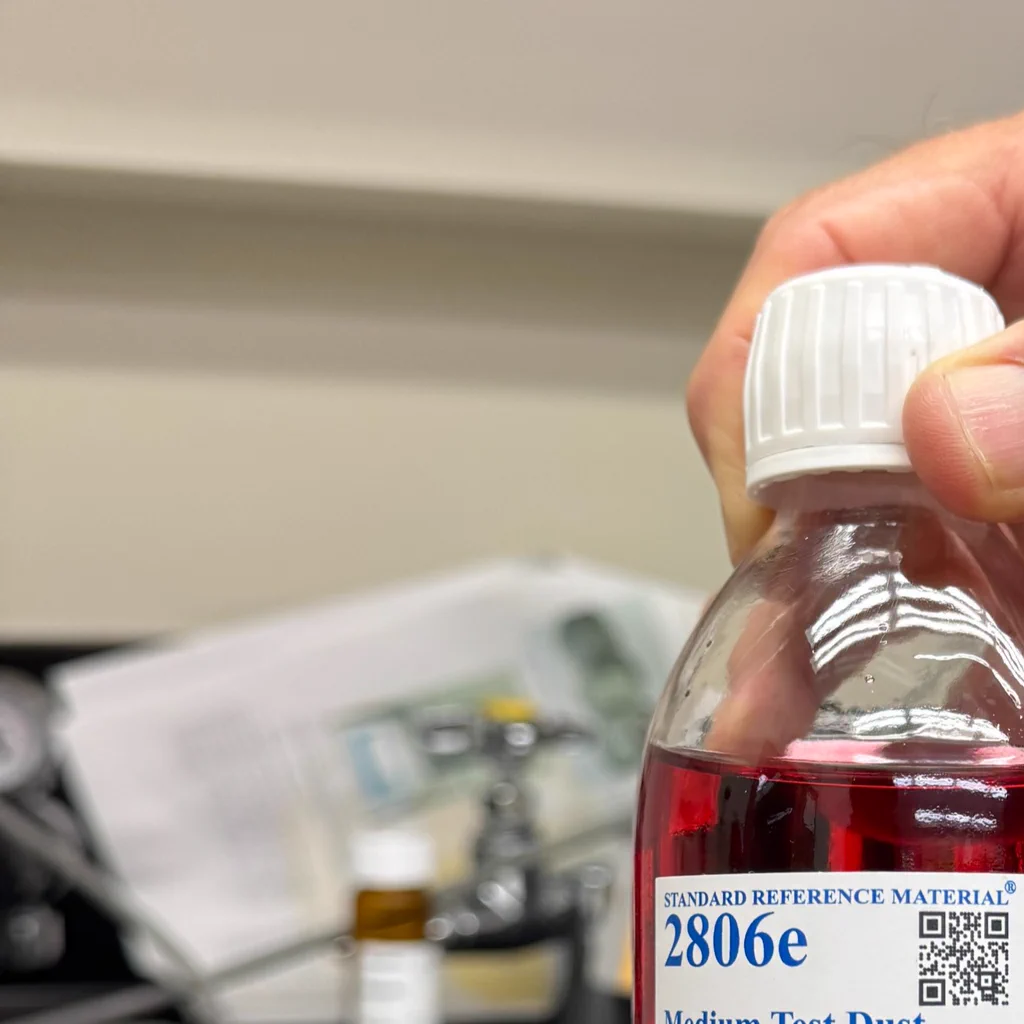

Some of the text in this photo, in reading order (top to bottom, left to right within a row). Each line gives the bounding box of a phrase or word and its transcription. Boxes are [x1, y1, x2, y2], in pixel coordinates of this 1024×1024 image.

[664, 890, 746, 907] STANDARD
[752, 888, 885, 905] REFERENCE
[664, 911, 808, 968] 2806e
